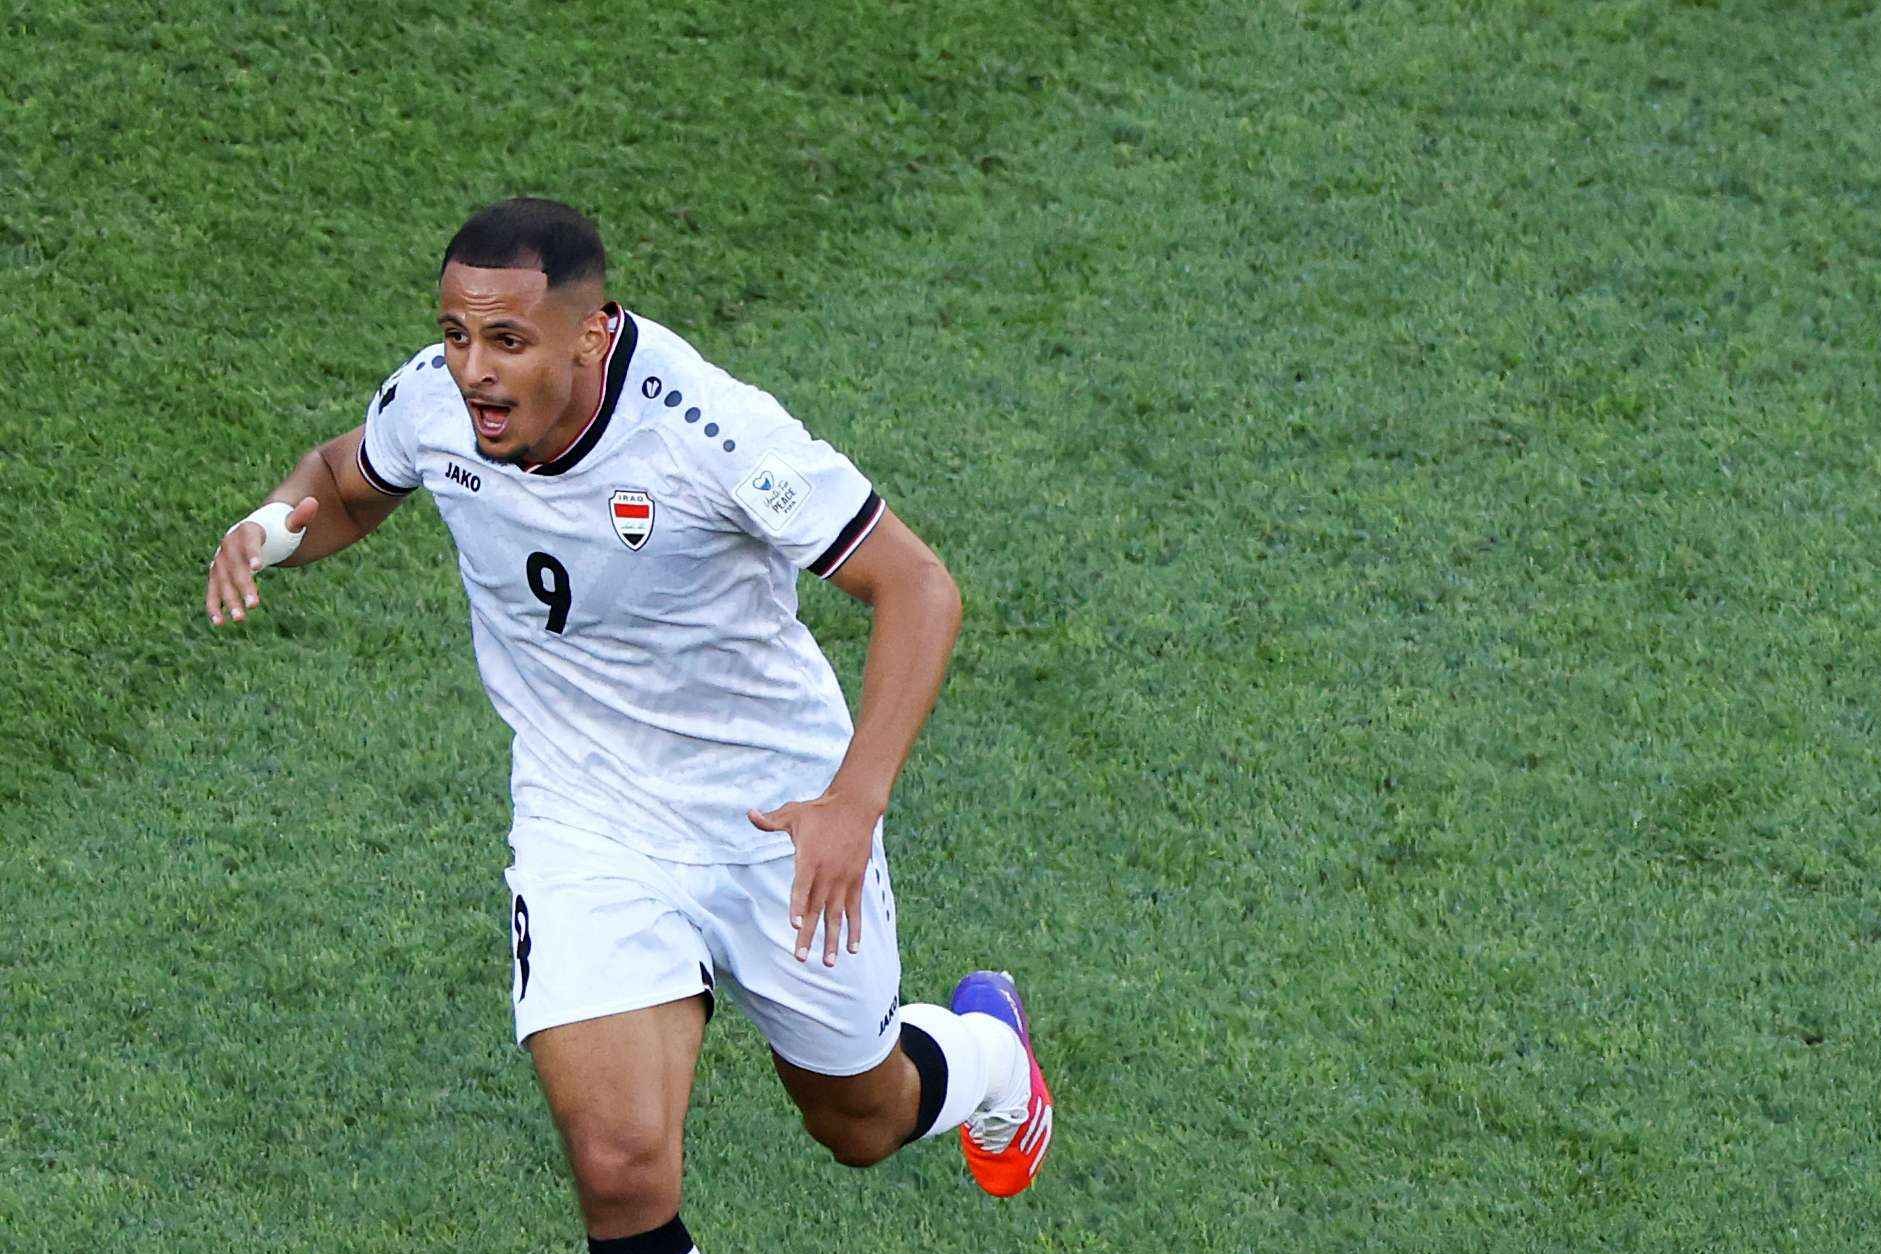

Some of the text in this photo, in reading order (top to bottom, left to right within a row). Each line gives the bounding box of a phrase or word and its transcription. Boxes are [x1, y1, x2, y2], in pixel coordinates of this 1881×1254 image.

[445, 461, 481, 492] JAKO
[772, 487, 796, 513] PEACE
[526, 551, 572, 634] 9
